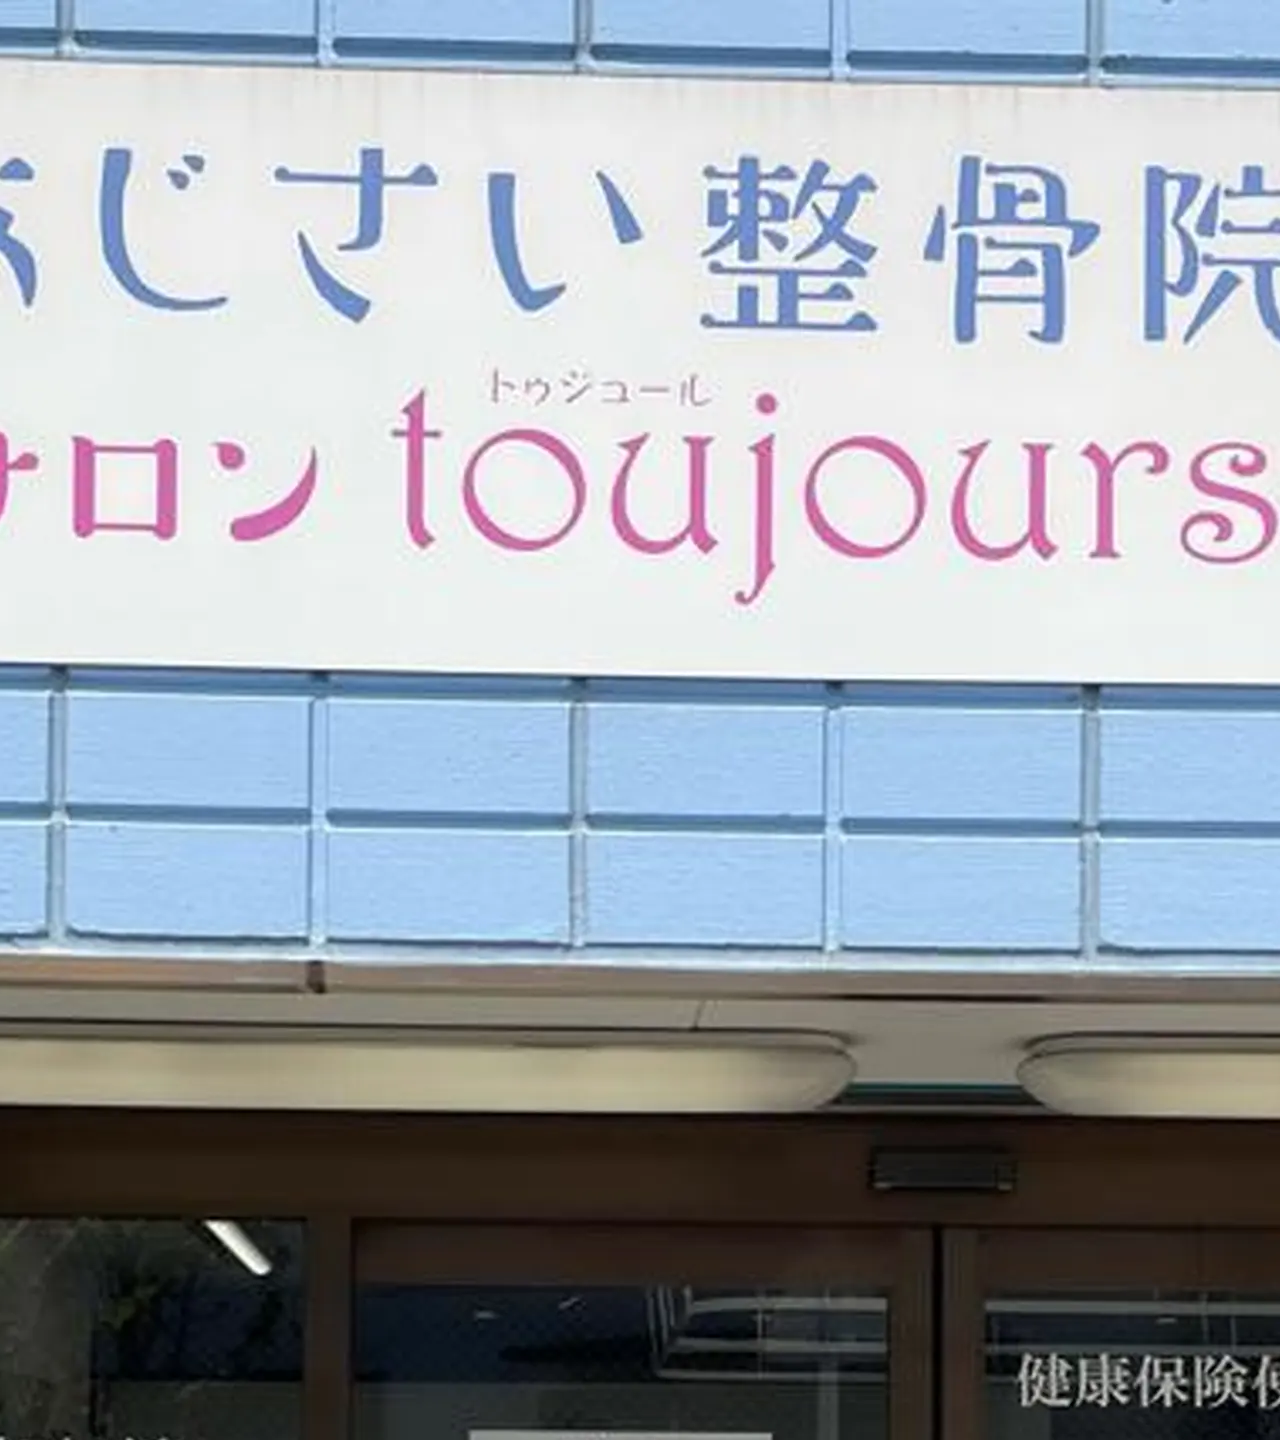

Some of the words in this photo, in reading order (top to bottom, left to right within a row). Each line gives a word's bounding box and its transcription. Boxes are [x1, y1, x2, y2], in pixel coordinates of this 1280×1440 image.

[486, 368, 713, 409] トゥジュール
[390, 387, 1280, 605] toujours
